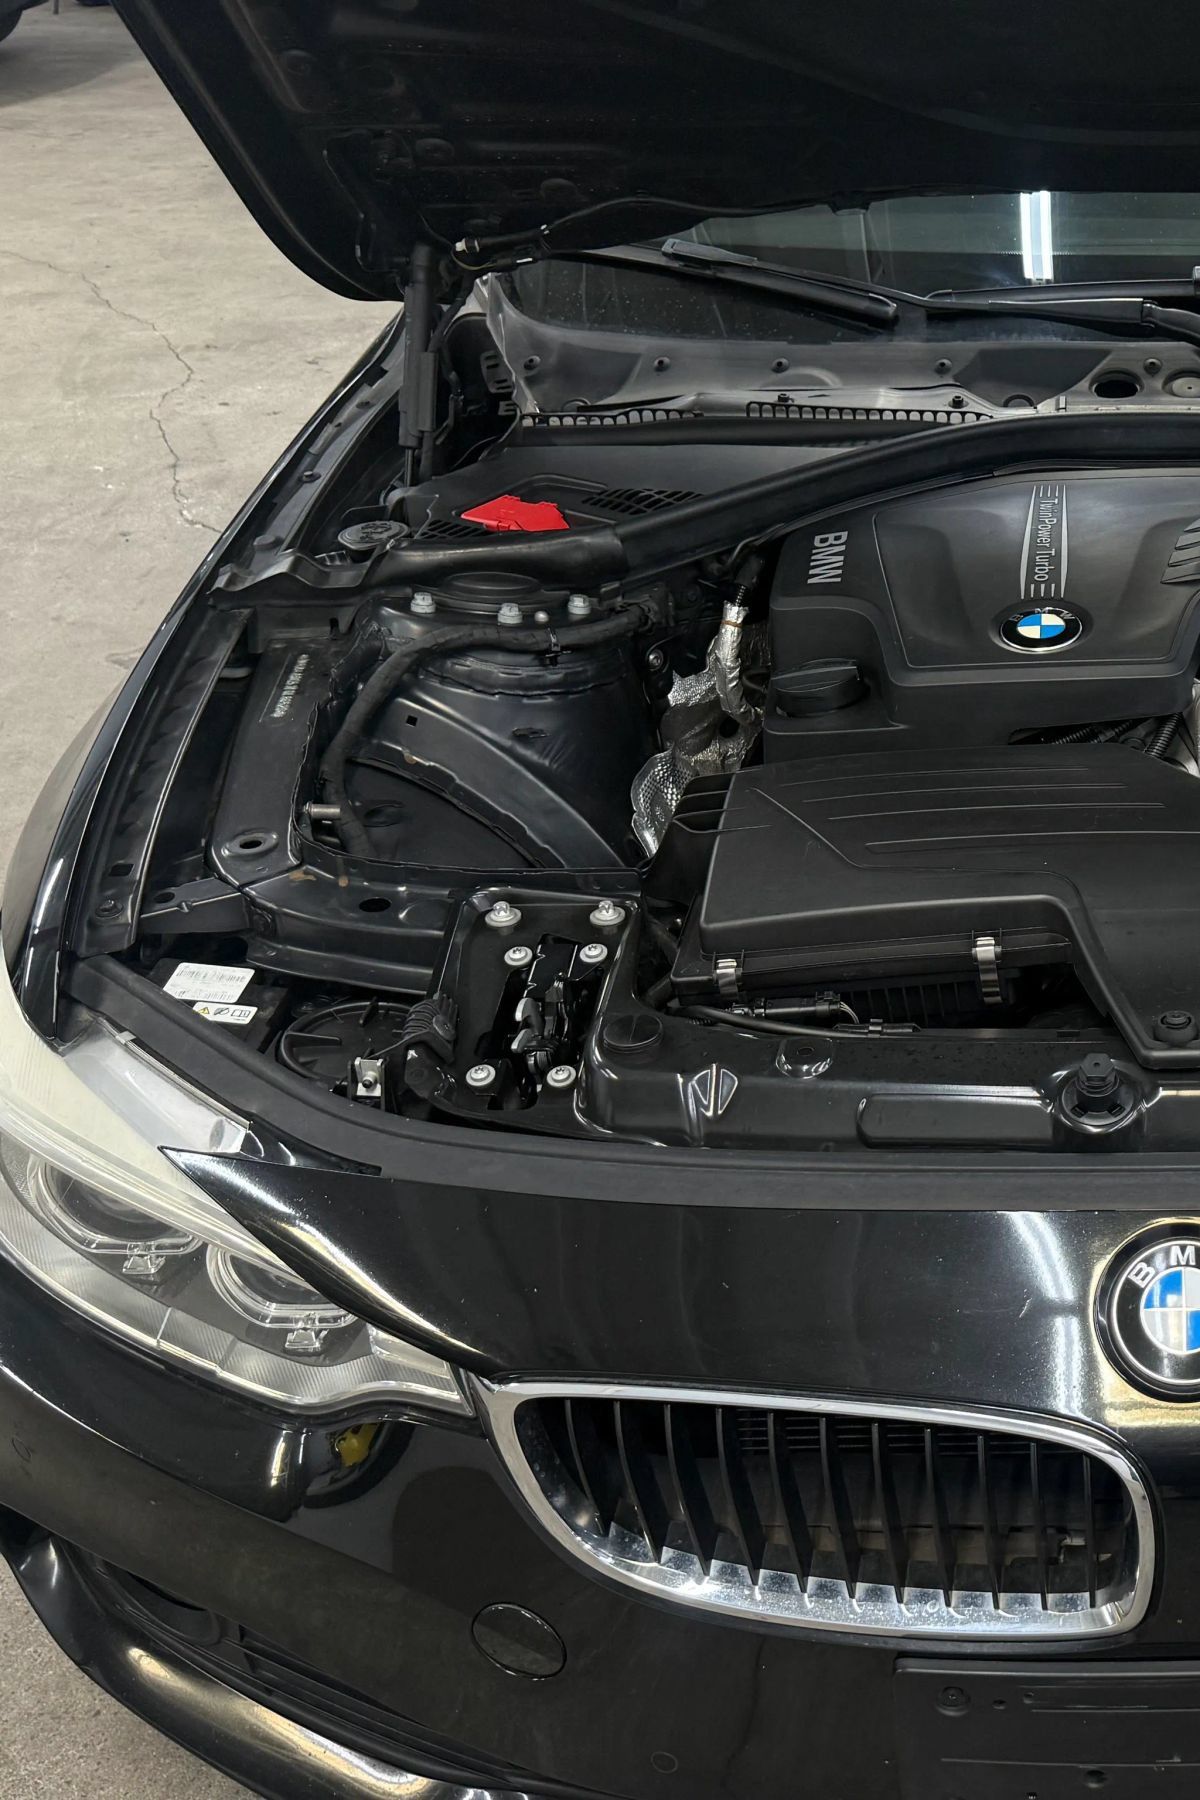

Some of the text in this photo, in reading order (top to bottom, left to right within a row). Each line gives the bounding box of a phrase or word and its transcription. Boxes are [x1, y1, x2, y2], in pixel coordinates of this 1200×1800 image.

[807, 530, 848, 584] BMW
[1034, 498, 1059, 581] TwinPower Turbo
[1009, 606, 1075, 622] BMW
